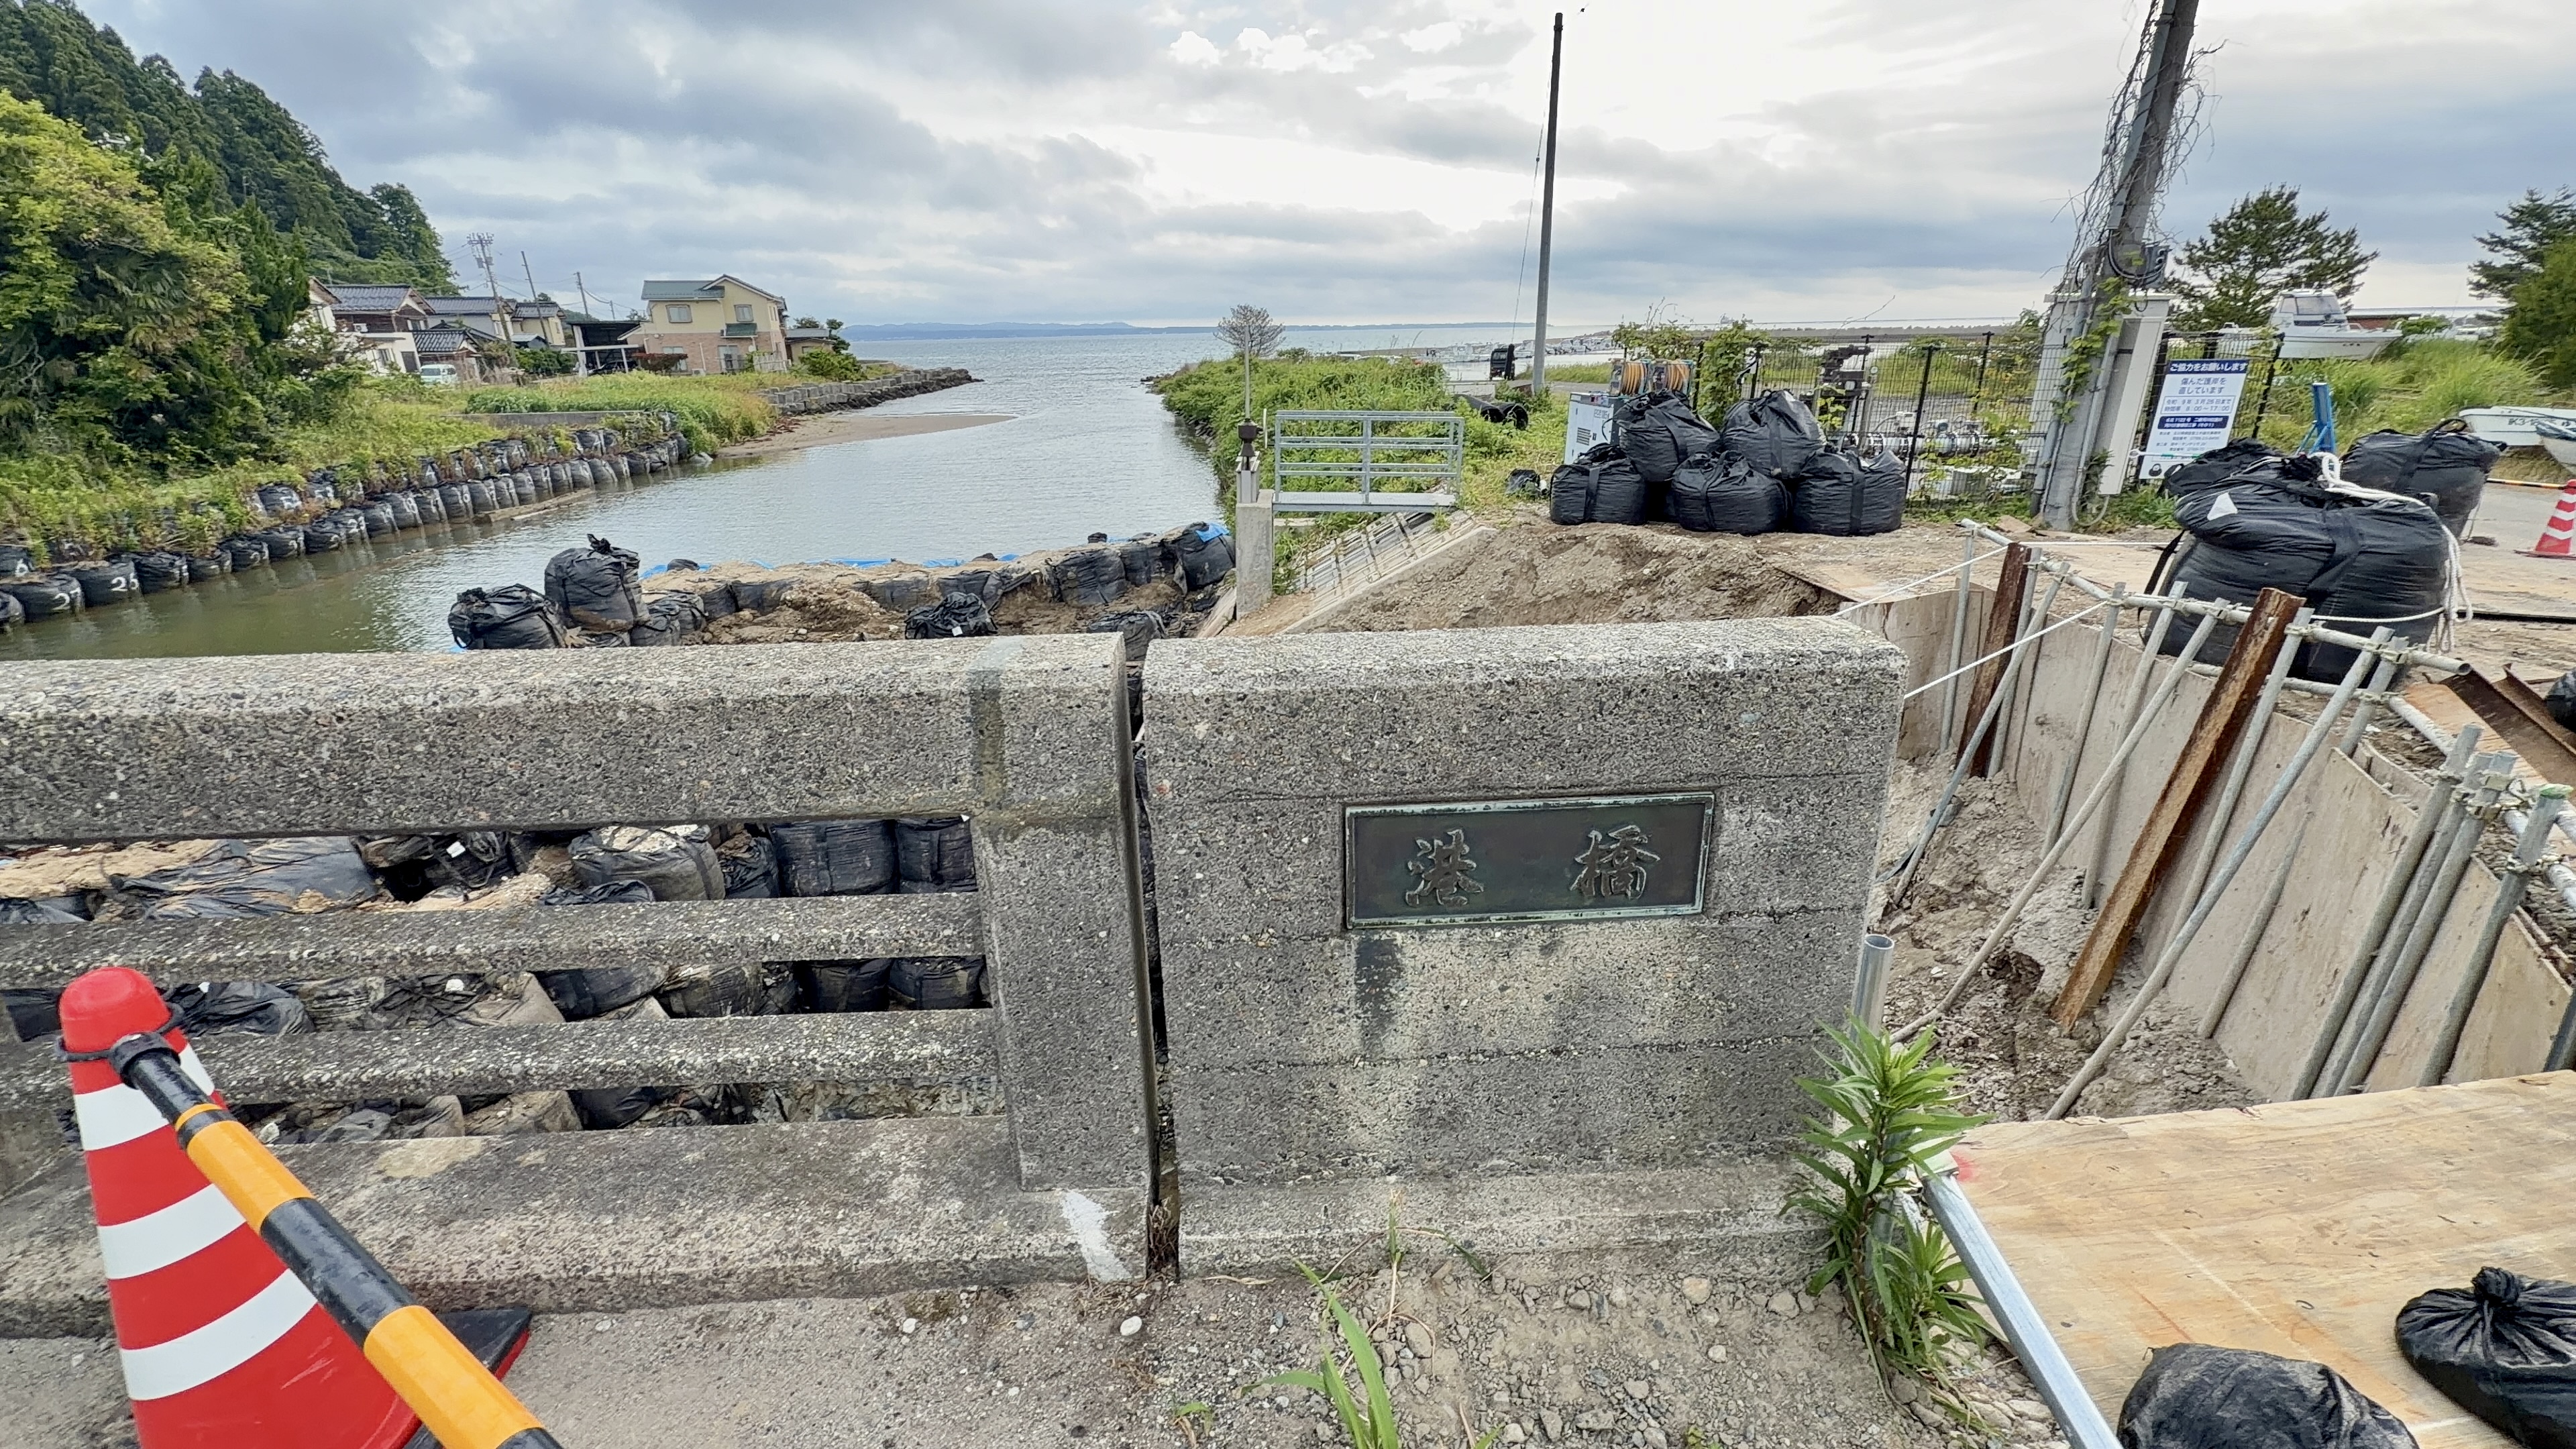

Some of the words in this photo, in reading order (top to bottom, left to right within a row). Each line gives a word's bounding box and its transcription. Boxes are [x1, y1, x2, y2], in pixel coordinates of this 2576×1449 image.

[2169, 362, 2247, 372] ご協力をお願いします
[2180, 377, 2227, 386] 傷んだ護岸を
[2178, 386, 2224, 394] 直しています
[109, 571, 140, 592] 26
[52, 586, 83, 611] 27
